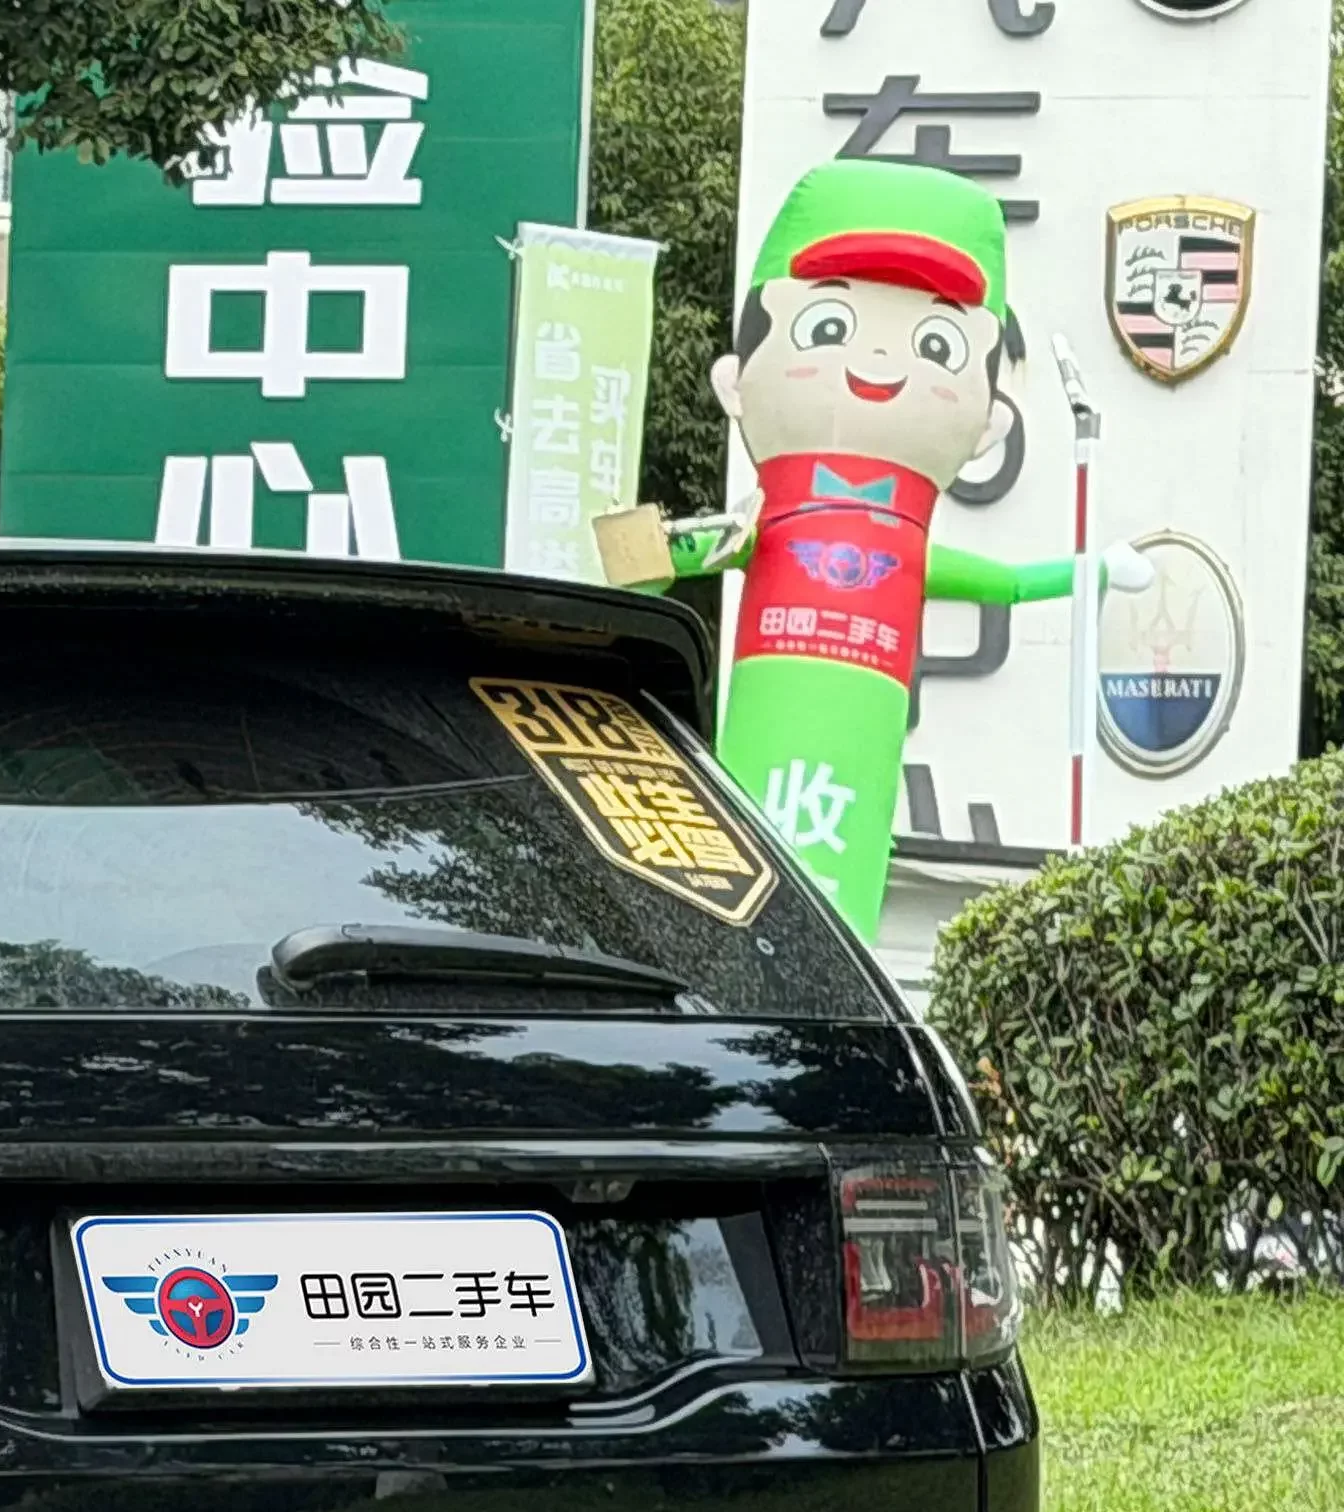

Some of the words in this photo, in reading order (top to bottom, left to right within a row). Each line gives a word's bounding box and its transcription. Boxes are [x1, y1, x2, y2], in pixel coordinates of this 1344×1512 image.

[1118, 213, 1245, 238] PORSCHE
[759, 606, 900, 653] 田园二手车
[1106, 677, 1213, 698] MASERATI
[480, 684, 641, 753] 318
[763, 758, 856, 897] 收
[300, 1271, 556, 1319] 田园二手车
[348, 1334, 528, 1352] 综合性一站式服务企业
